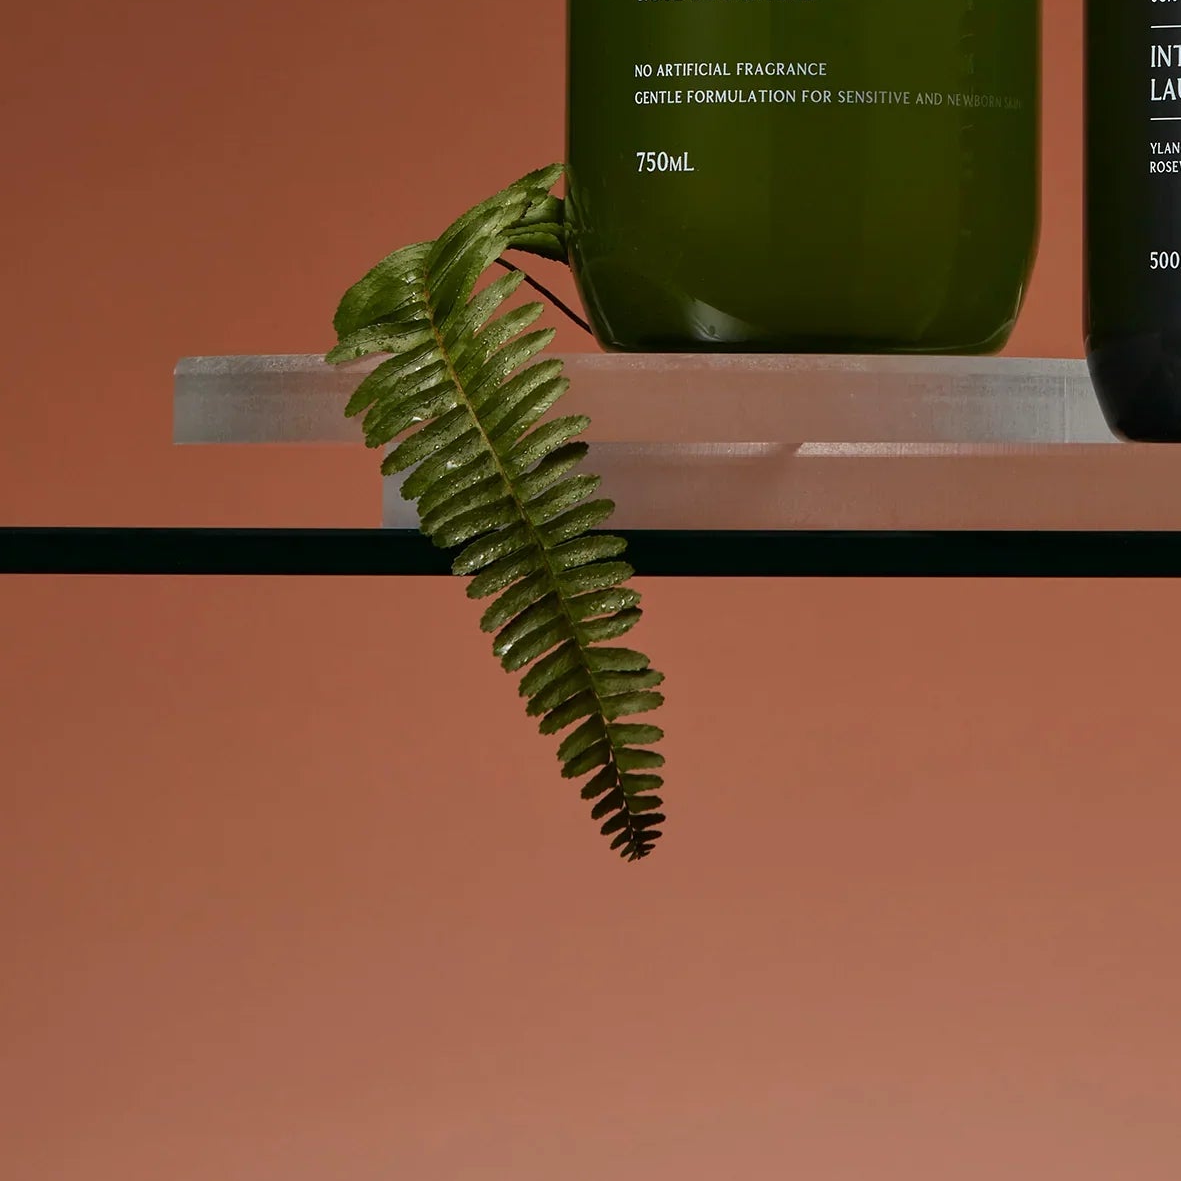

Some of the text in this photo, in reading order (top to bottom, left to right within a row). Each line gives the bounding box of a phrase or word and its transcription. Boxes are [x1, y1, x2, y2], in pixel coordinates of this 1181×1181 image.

[633, 61, 828, 78] NO ARTIFICIAL FRAGRANCE
[634, 89, 683, 106] GENTLE
[686, 88, 797, 105] FORMULATION
[801, 89, 833, 104] FOR
[837, 89, 911, 106] SENSITIVE
[915, 91, 943, 106] AND
[946, 92, 1002, 109] NEWBORN
